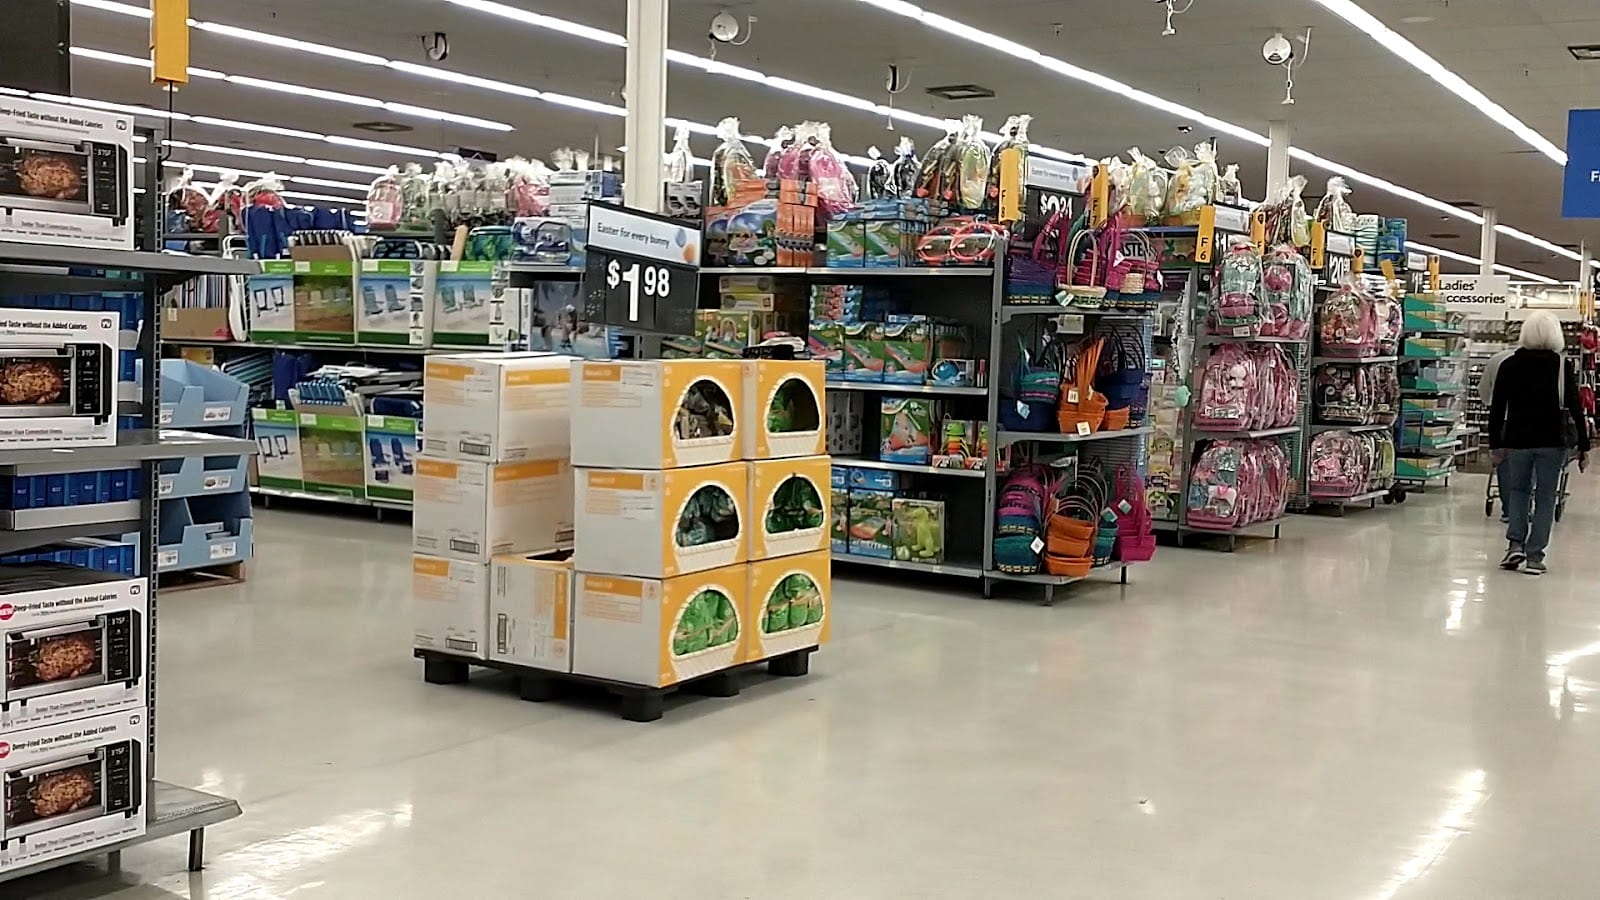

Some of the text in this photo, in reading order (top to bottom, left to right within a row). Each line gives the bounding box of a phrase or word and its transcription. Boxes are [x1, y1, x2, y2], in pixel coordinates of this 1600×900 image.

[597, 222, 670, 249] Easter for every bunny
[1201, 238, 1208, 247] F
[1439, 280, 1477, 290] Ladies'
[1441, 293, 1505, 303] ccessories
[42, 601, 54, 609] Taste
[56, 598, 74, 607] without
[12, 740, 40, 750] Deep-Fried
[55, 734, 73, 742] without
[83, 728, 98, 736] Added
[99, 725, 116, 734] Calories
